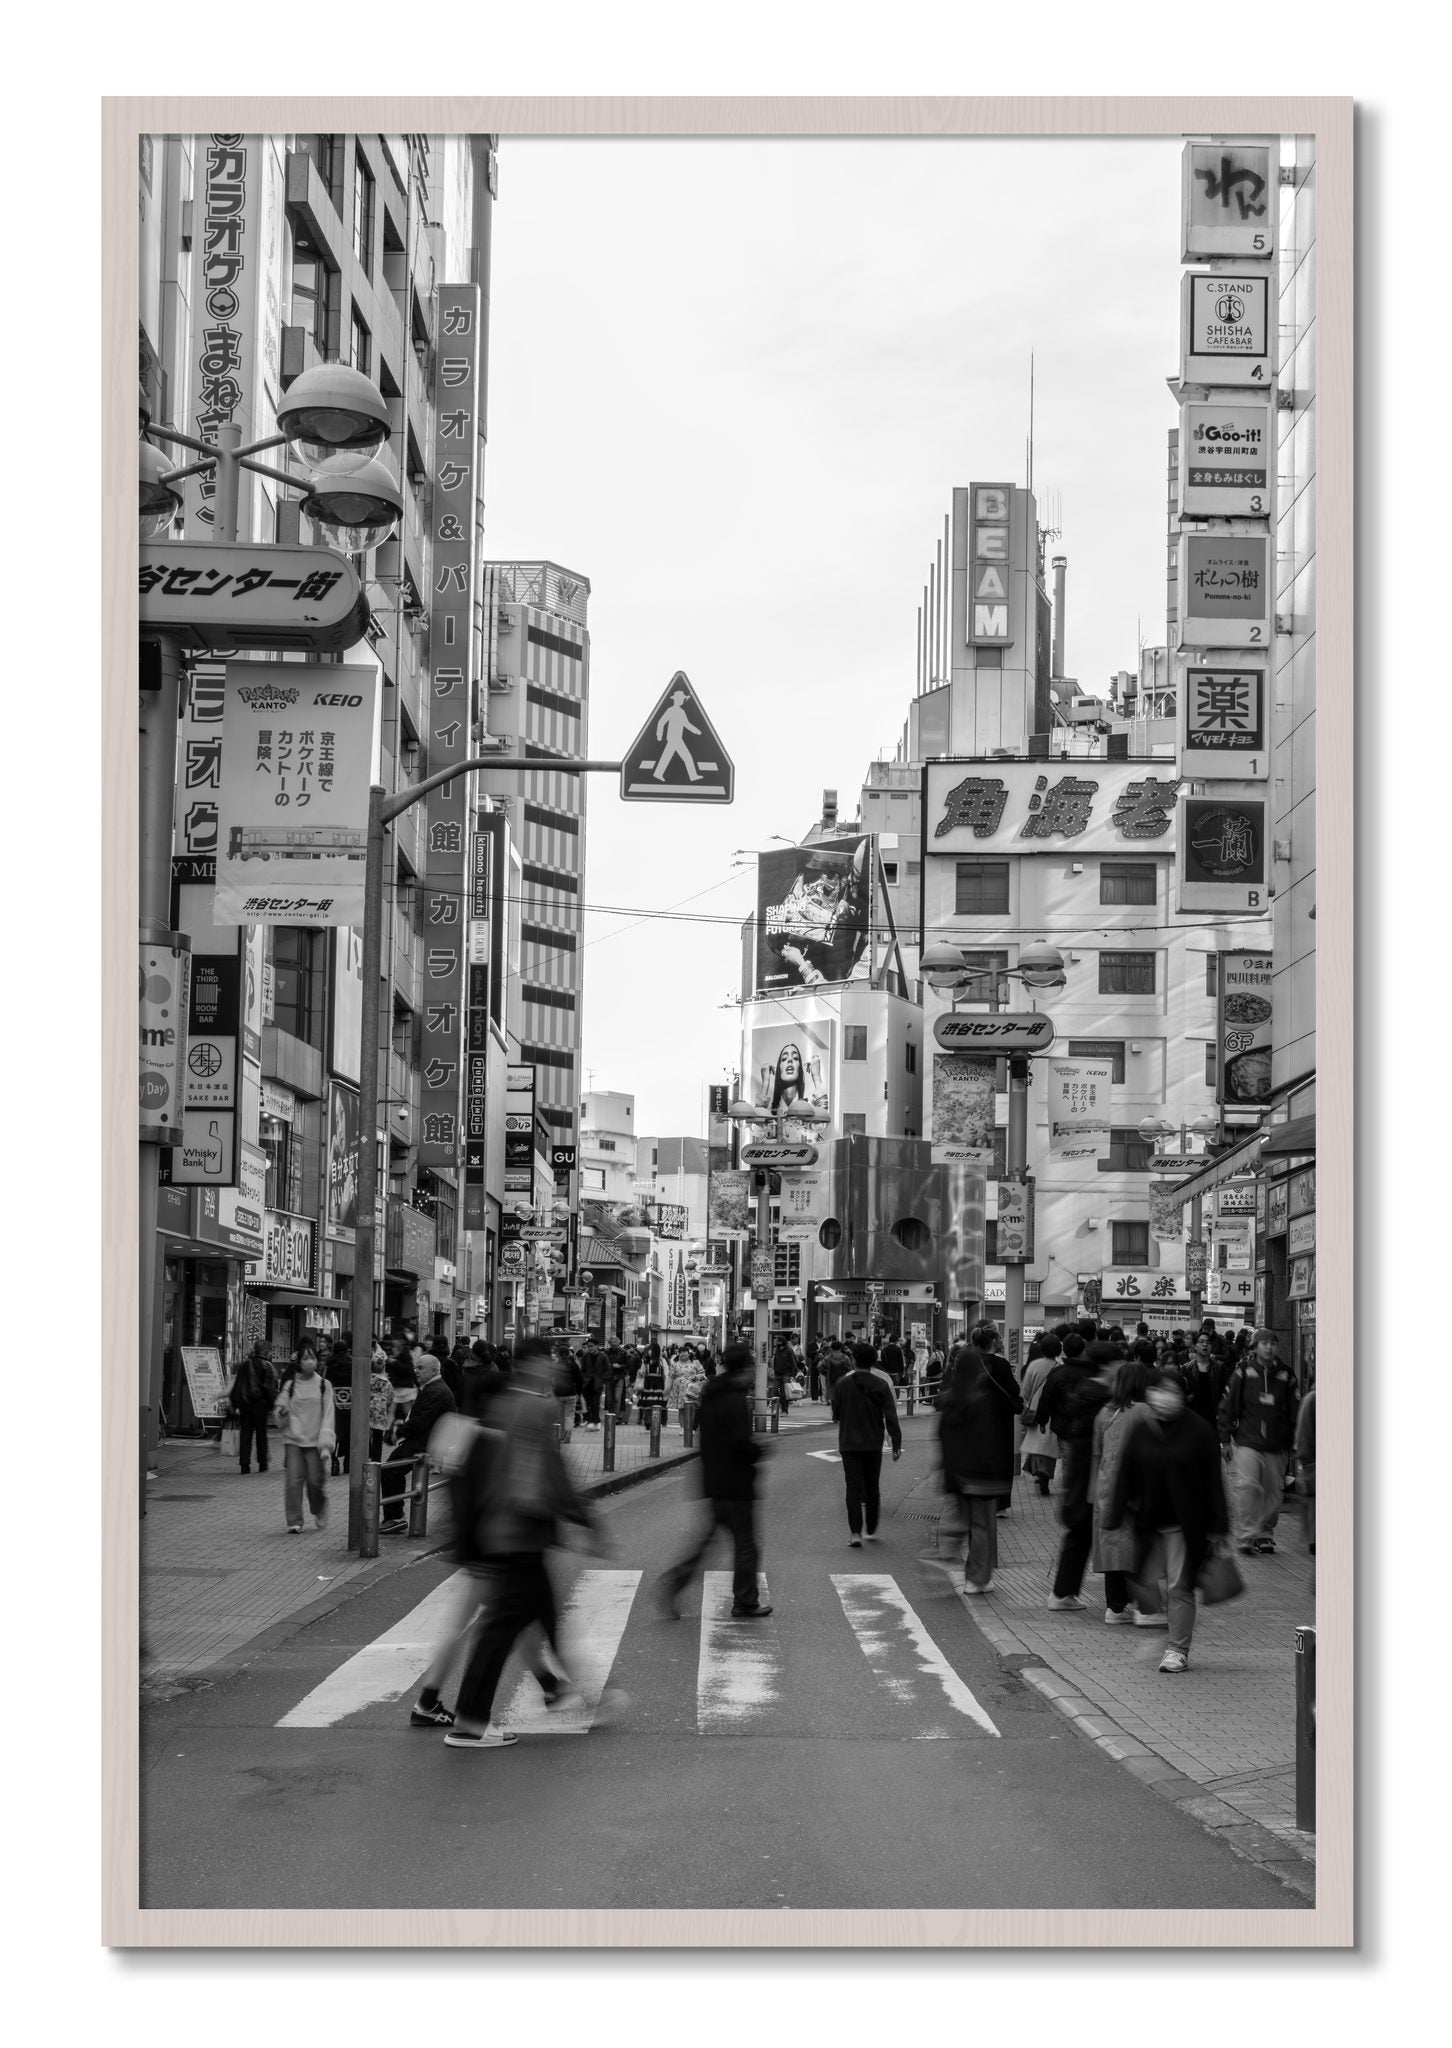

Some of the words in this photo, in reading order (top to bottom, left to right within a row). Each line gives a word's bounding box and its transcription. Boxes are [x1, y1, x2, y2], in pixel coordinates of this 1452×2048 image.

[204, 146, 247, 289] カラオケ
[1252, 234, 1265, 250] 5
[1206, 283, 1253, 293] C.STAND
[1206, 325, 1253, 337] SHISHA
[1198, 446, 1258, 456] 渋谷宇田川町店
[1192, 471, 1263, 485] 全身もみほぐし
[1250, 495, 1263, 512] 3
[974, 487, 1010, 637] BEAM
[1193, 569, 1260, 590] ポムの樹
[1204, 592, 1252, 601] Pomme-no-ki
[1249, 626, 1262, 643] 2
[251, 701, 288, 710] KANTO
[312, 693, 363, 708] KEIO
[1197, 676, 1249, 729] 薬
[1191, 732, 1255, 747] マツモトキヨシ
[255, 730, 273, 774] 冒険へ
[275, 730, 293, 807] カントーの
[296, 730, 315, 807] ポケパーク
[318, 731, 336, 793] 京王線で
[1249, 758, 1258, 775] 1
[476, 836, 485, 874] kimono
[242, 897, 335, 911] 渋谷センター街
[1248, 890, 1260, 907] B
[200, 967, 215, 975] THE
[196, 975, 218, 983] THIRD
[195, 1004, 218, 1012] ROOM
[199, 1015, 214, 1023] BAR
[941, 1022, 1047, 1036] 渋谷センター街
[1225, 1031, 1255, 1052] 6F
[183, 1148, 218, 1160] Whisky
[554, 1151, 575, 1163] GU
[745, 1148, 809, 1159] 渋谷センター街
[182, 1158, 204, 1167] Bank
[675, 1273, 686, 1317] BEER
